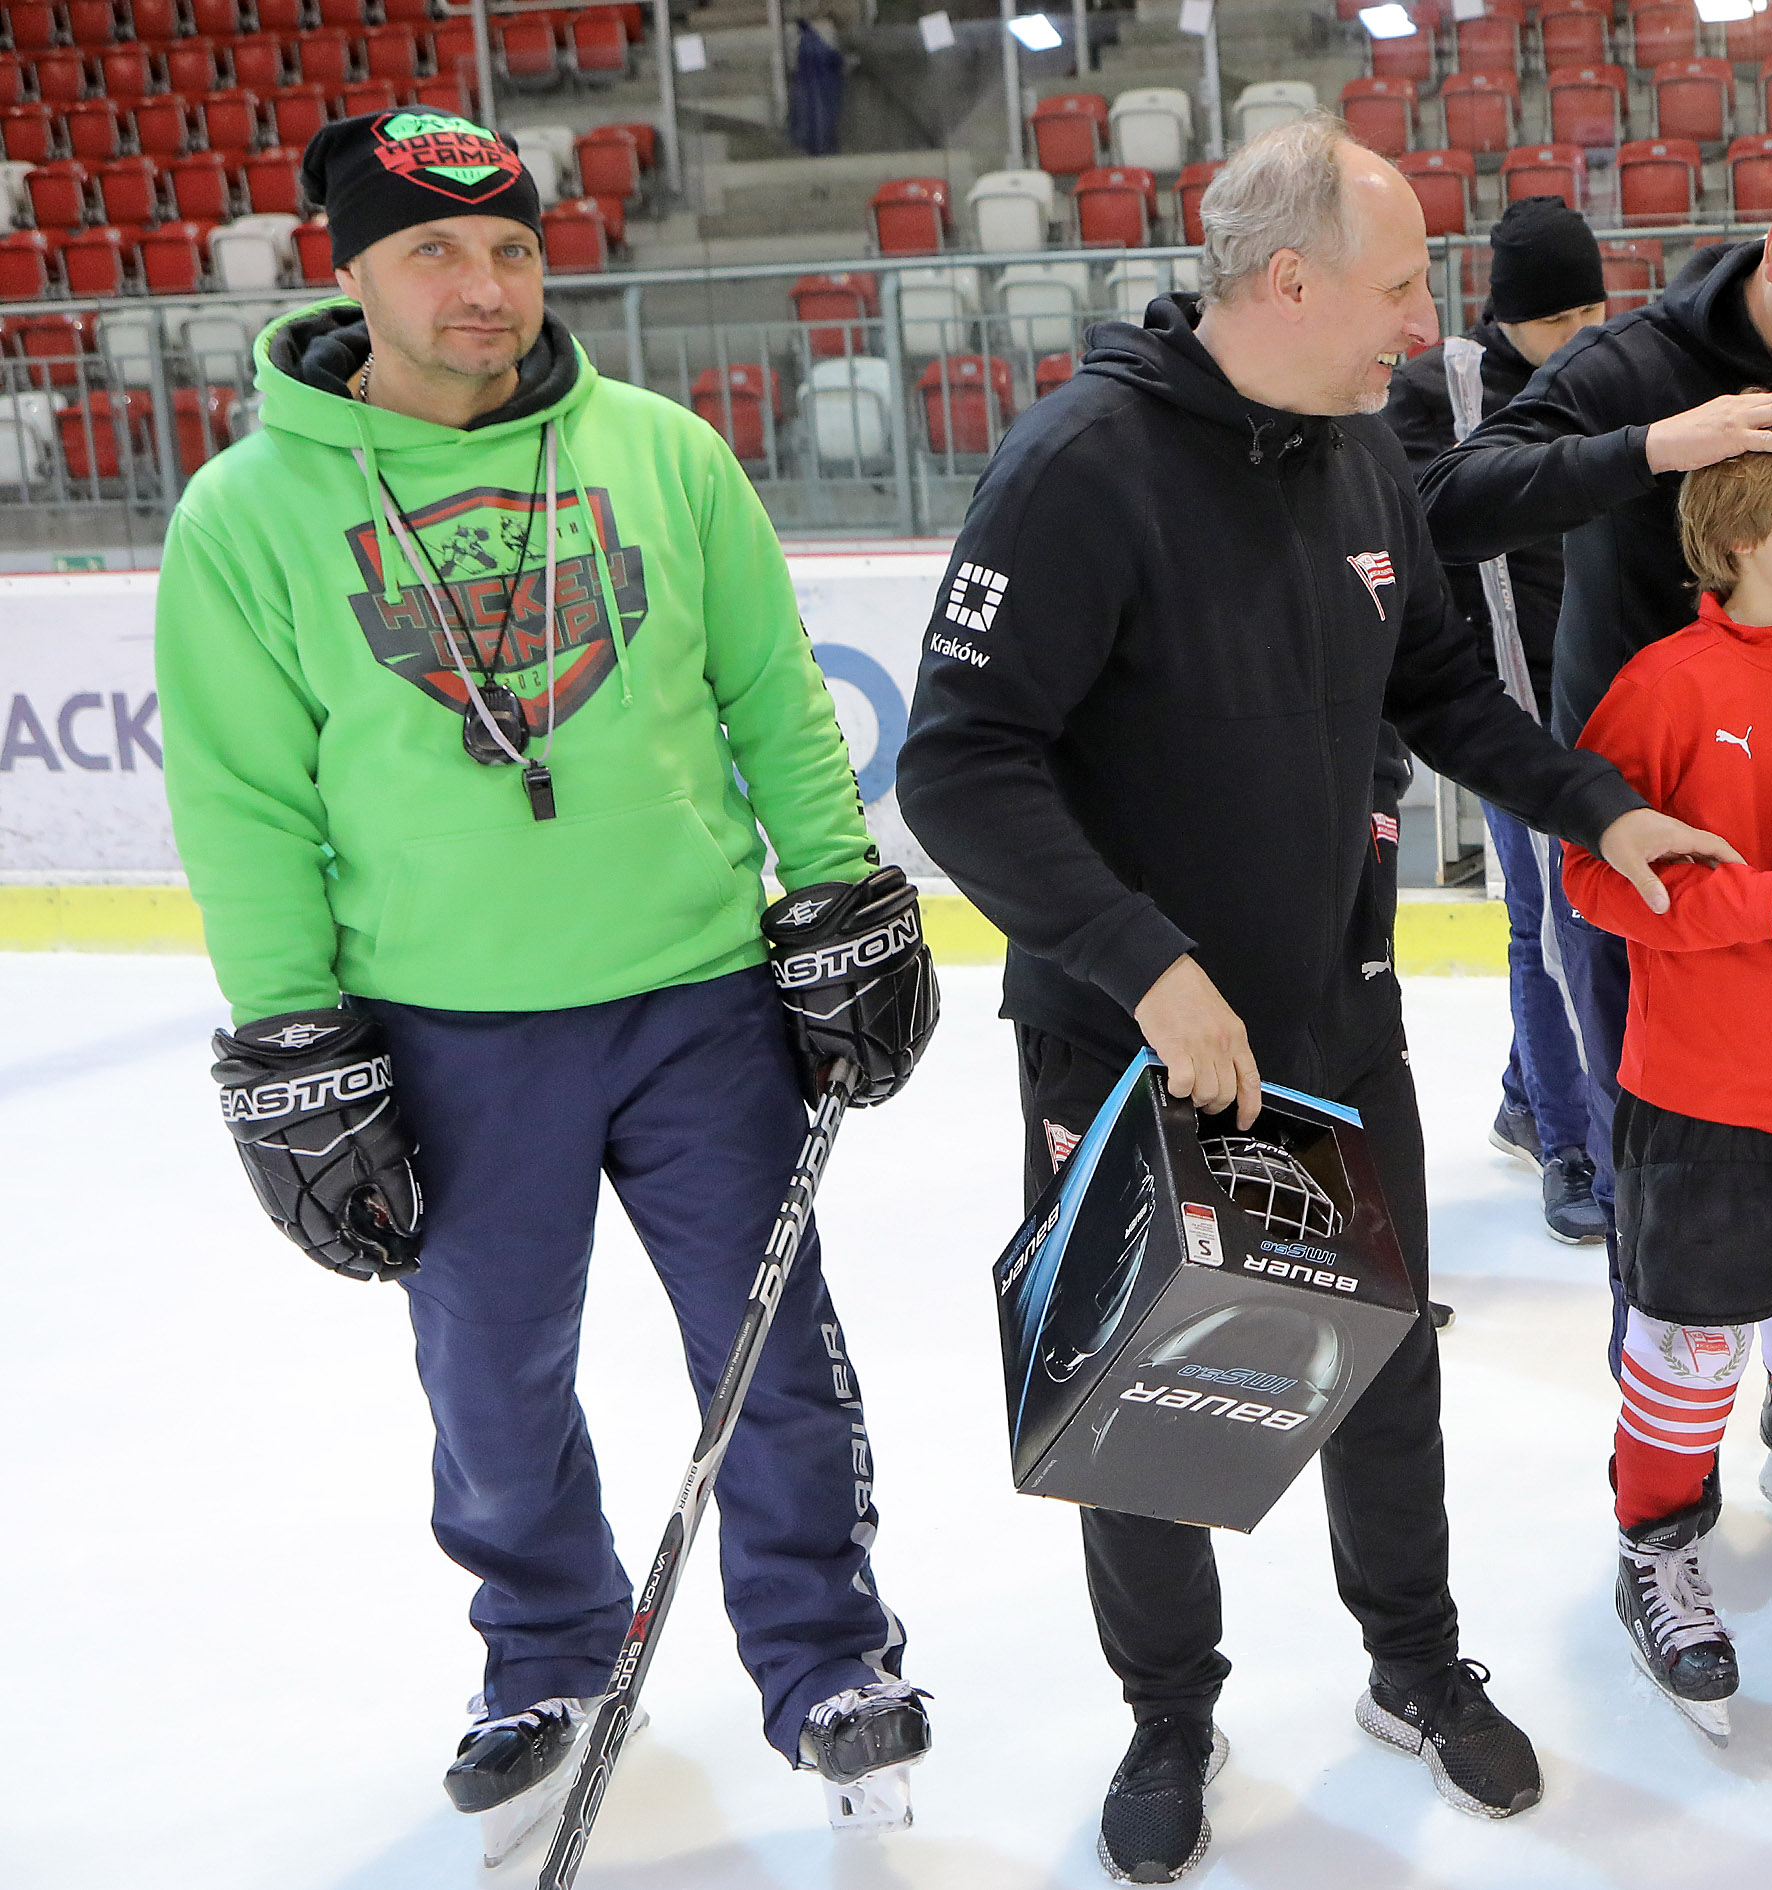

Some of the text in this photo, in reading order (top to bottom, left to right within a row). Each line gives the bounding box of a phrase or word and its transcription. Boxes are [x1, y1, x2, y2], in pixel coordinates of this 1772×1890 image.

[412, 148, 502, 166] CAMP
[372, 552, 629, 630] HOCKEY
[431, 600, 600, 668] CAMP
[930, 632, 990, 669] Kraków
[220, 1054, 394, 1122] EASTON
[1198, 1239, 1212, 1257] S
